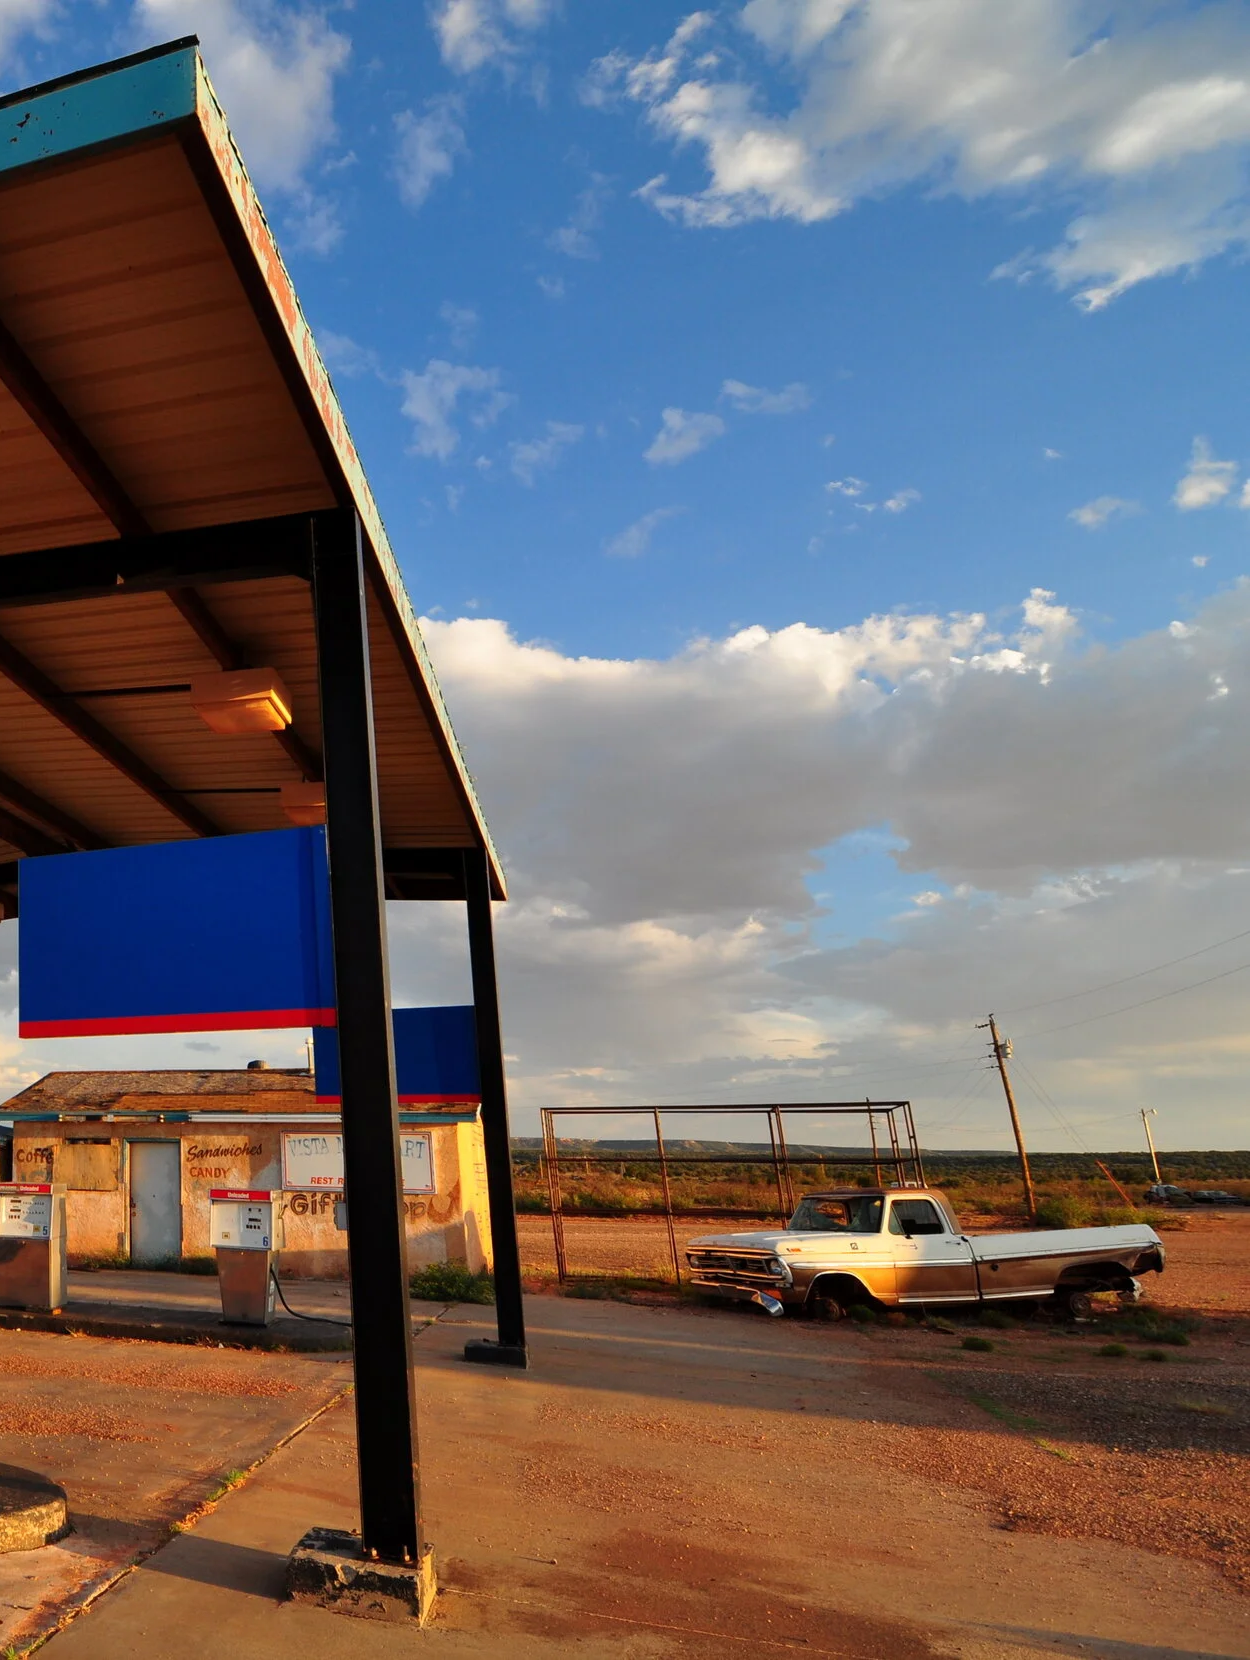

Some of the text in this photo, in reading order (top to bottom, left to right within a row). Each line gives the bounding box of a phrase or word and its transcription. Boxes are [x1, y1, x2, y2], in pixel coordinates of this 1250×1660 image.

[187, 1143, 263, 1162] Sandwiches
[190, 1167, 230, 1179] CANDY
[310, 1177, 334, 1186] REST
[227, 1191, 250, 1199] Unleaded
[43, 1225, 48, 1236] 5
[262, 1236, 269, 1247] 6
